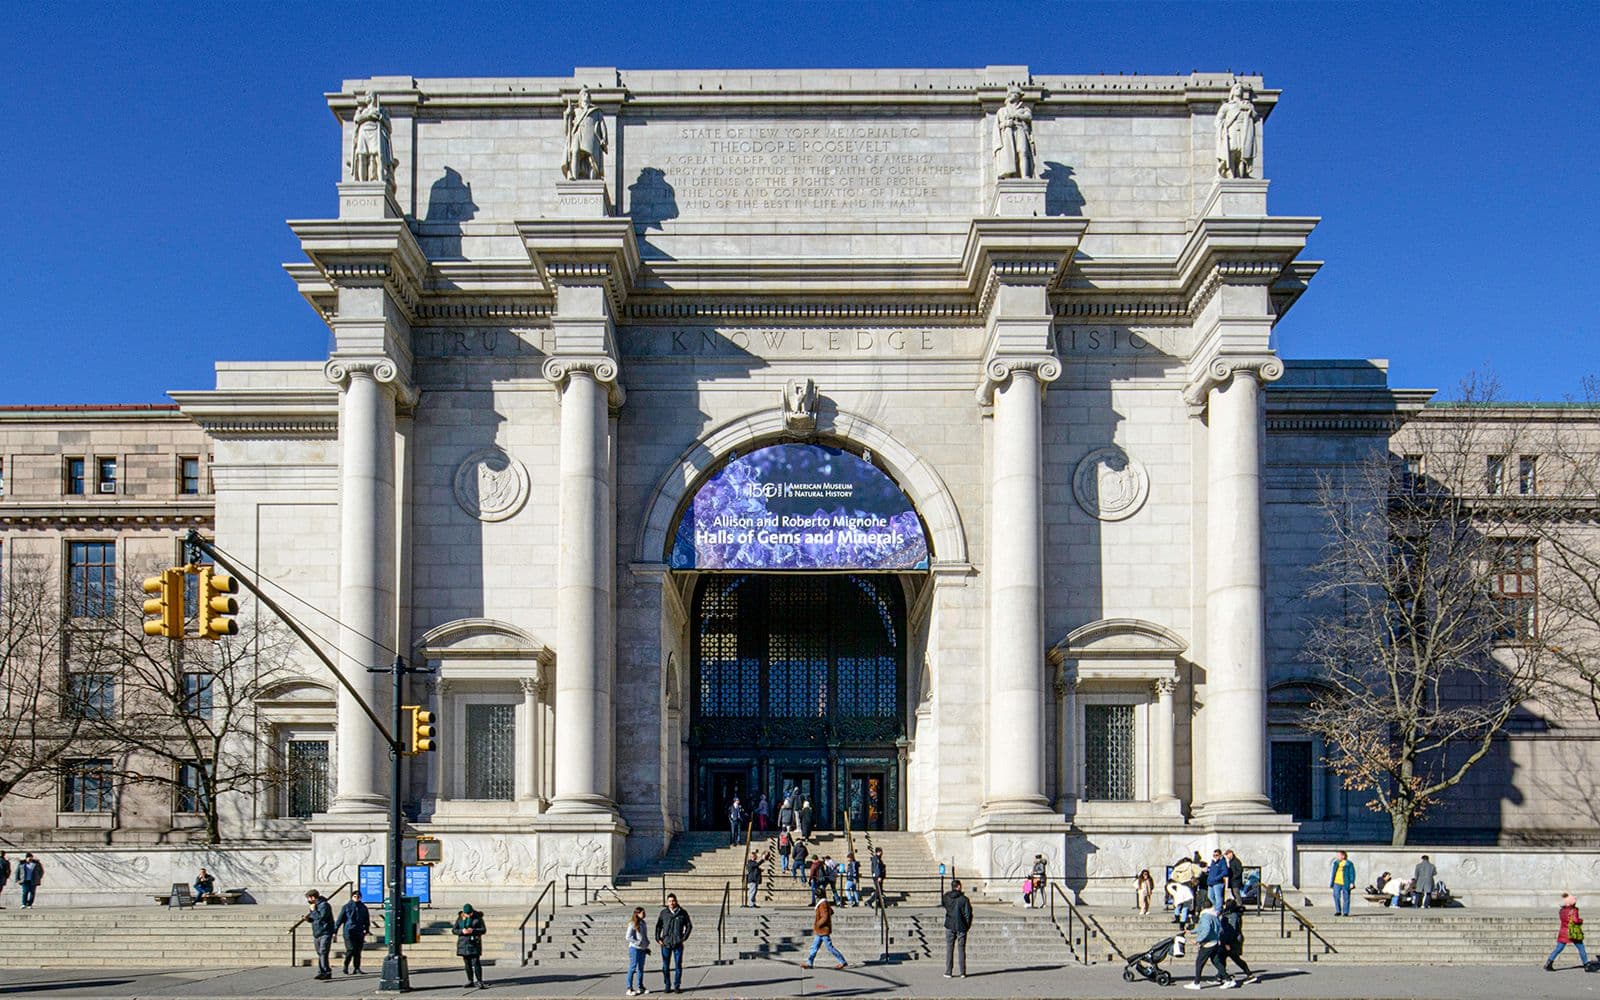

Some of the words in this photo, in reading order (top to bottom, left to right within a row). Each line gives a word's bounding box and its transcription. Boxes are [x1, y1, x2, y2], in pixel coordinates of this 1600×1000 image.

[682, 128, 721, 138] STATE
[726, 128, 743, 138] OF
[749, 128, 779, 138] NEW
[785, 128, 822, 138] YORK
[826, 128, 898, 138] MEMORIAL
[902, 128, 920, 138] TO
[710, 141, 797, 153] THEODORE
[803, 141, 891, 153] ROOSEVELT
[678, 155, 715, 164] GREAT
[722, 155, 764, 164] LEADER
[770, 155, 785, 164] OF
[791, 155, 813, 164] THE
[819, 155, 858, 164] YOUTH
[864, 155, 879, 164] OF
[884, 155, 935, 164] AMERICA
[701, 167, 724, 175] AND
[729, 167, 787, 175] FORTITUDE
[794, 167, 805, 175] IN
[809, 167, 831, 175] THE
[834, 167, 865, 175] FAITH
[870, 167, 884, 175] OF
[888, 167, 911, 175] OUR
[917, 167, 962, 175] FATHERS
[674, 178, 686, 186] IN
[692, 178, 740, 186] DEFENSE
[745, 178, 760, 186] OF
[765, 178, 786, 186] THE
[793, 178, 835, 186] RIGHTS
[839, 178, 854, 186] OF
[859, 178, 881, 186] THE
[886, 178, 927, 186] PEOPLE
[682, 189, 703, 198] THE
[709, 189, 738, 198] LOVE
[743, 189, 768, 198] AND
[774, 189, 864, 198] CONSERVATION
[870, 189, 885, 198] OF
[891, 189, 937, 198] NATURE
[685, 200, 710, 208] AND
[716, 200, 730, 208] OF
[735, 200, 758, 208] THE
[764, 200, 790, 208] BEST
[795, 200, 807, 208] IN
[813, 200, 836, 208] LIFE
[842, 200, 867, 208] AND
[872, 200, 885, 208] IN
[890, 200, 916, 208] MAN
[671, 331, 935, 351] KNOWLEDGE
[747, 483, 777, 498] 150
[713, 516, 753, 528] Allison
[757, 516, 778, 528] and
[782, 516, 830, 528] Roberto
[833, 516, 887, 530] Mignone
[696, 530, 733, 544] Halls
[740, 530, 754, 544] of
[757, 531, 800, 544] Gems
[805, 530, 833, 544] and
[837, 530, 904, 544] Minerals
